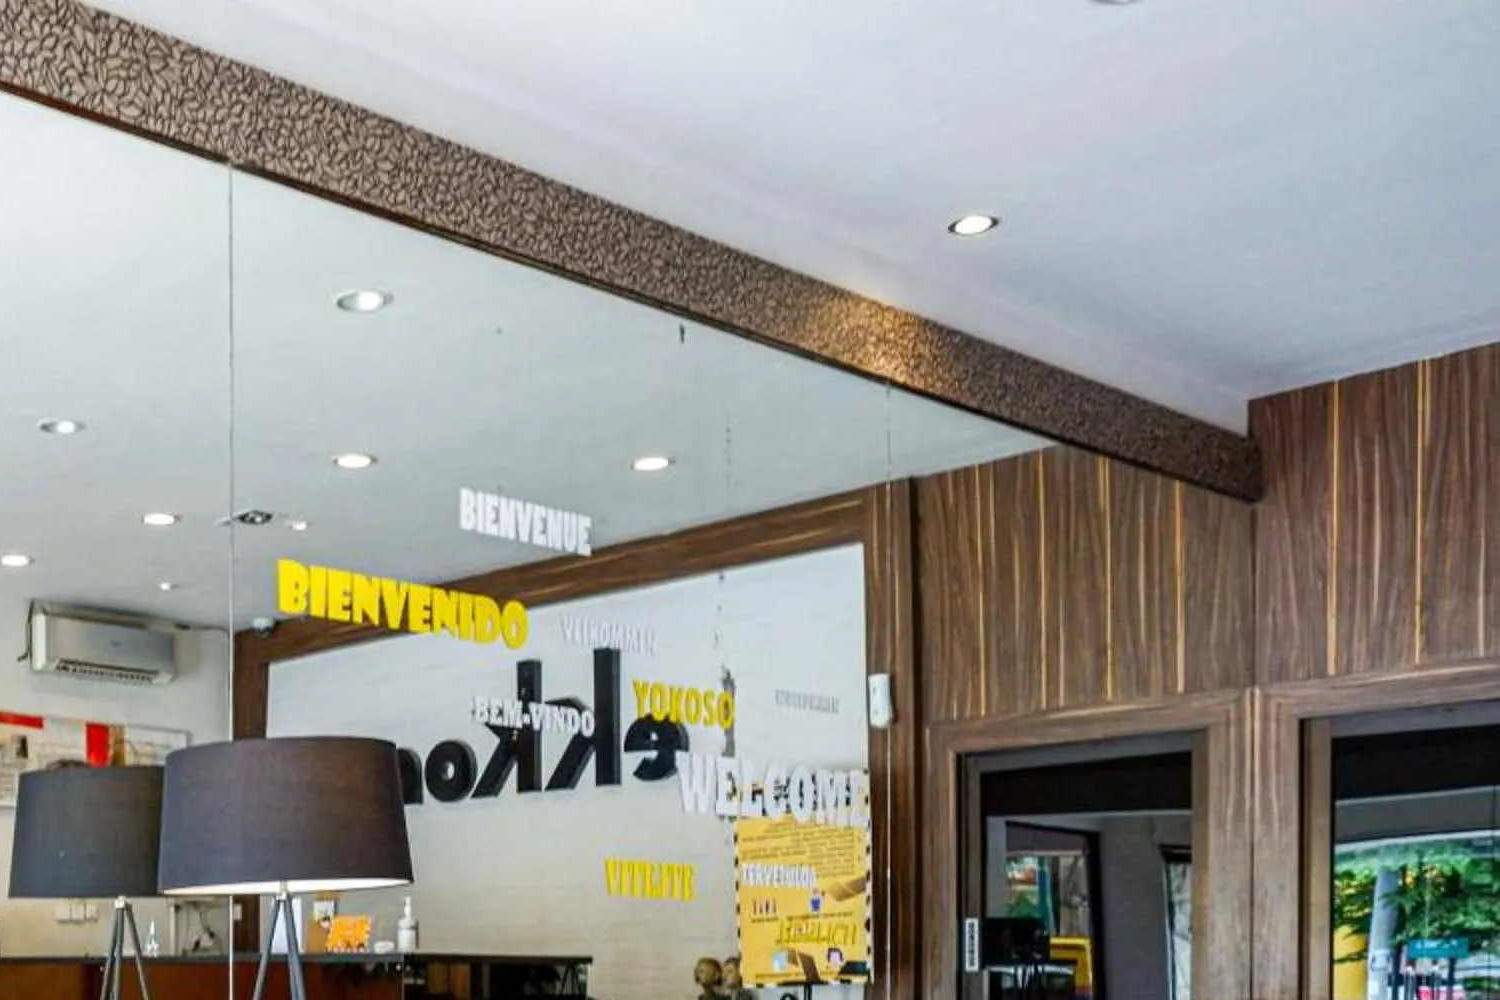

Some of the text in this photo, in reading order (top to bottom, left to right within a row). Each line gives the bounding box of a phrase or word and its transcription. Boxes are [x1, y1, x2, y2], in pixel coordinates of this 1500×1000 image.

[459, 487, 592, 557] BIENVENUE
[277, 558, 529, 650] BIENVENIDO
[475, 696, 595, 737] BEM-VINDO
[632, 678, 736, 729] YOKOSO
[675, 750, 870, 829] WELCOME
